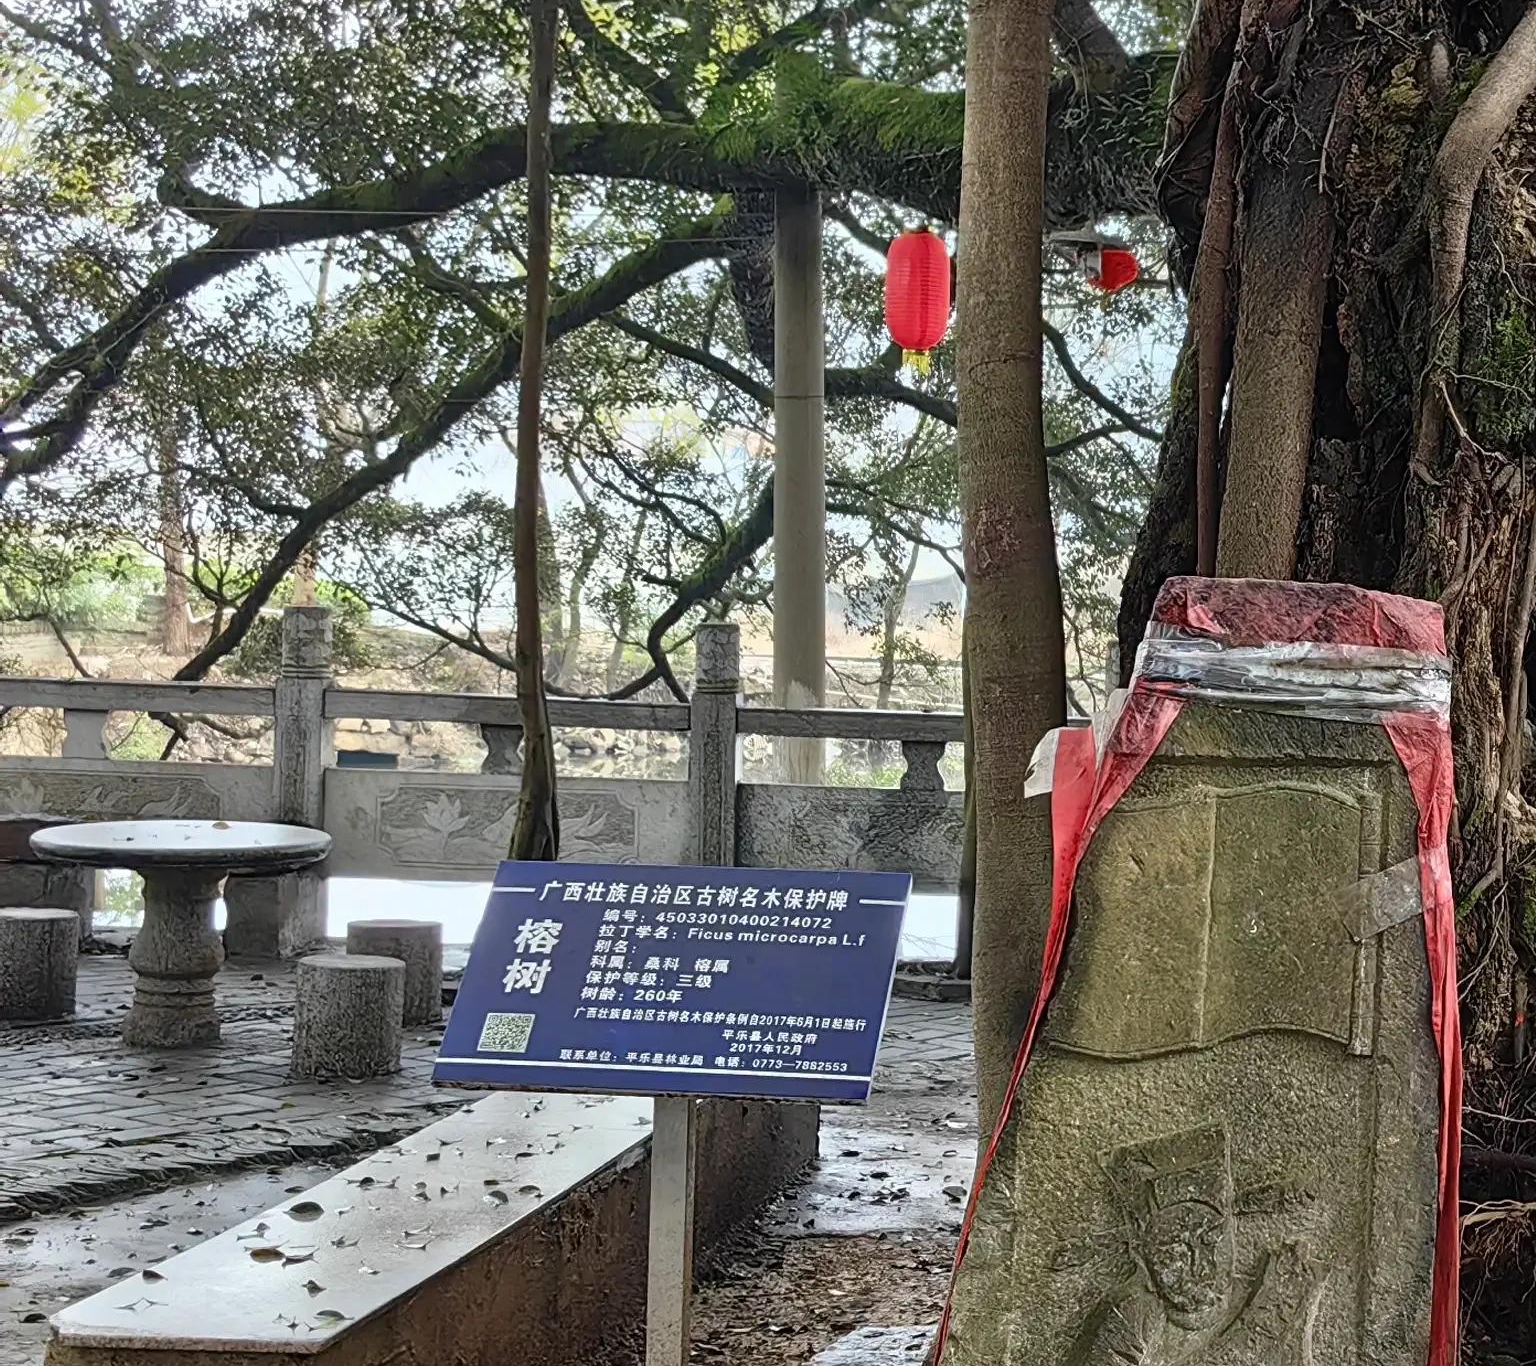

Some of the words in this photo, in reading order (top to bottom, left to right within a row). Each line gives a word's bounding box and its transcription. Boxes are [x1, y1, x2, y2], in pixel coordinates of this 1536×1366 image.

[539, 881, 849, 911] 广西壮族自治区古树名木保护牌
[737, 930, 837, 946] microcarpa
[842, 934, 866, 947] L.f
[502, 919, 563, 994] 榕树
[694, 958, 730, 974] 榕属
[585, 970, 713, 989] 保护等级：三级
[580, 986, 683, 1004] 树龄：260年
[573, 1006, 867, 1032] 广西壮族自治区古树名木保护条例自2017年6月1日起施行
[721, 1029, 818, 1045] 平乐县人民政府
[729, 1043, 803, 1056] 2017年12月
